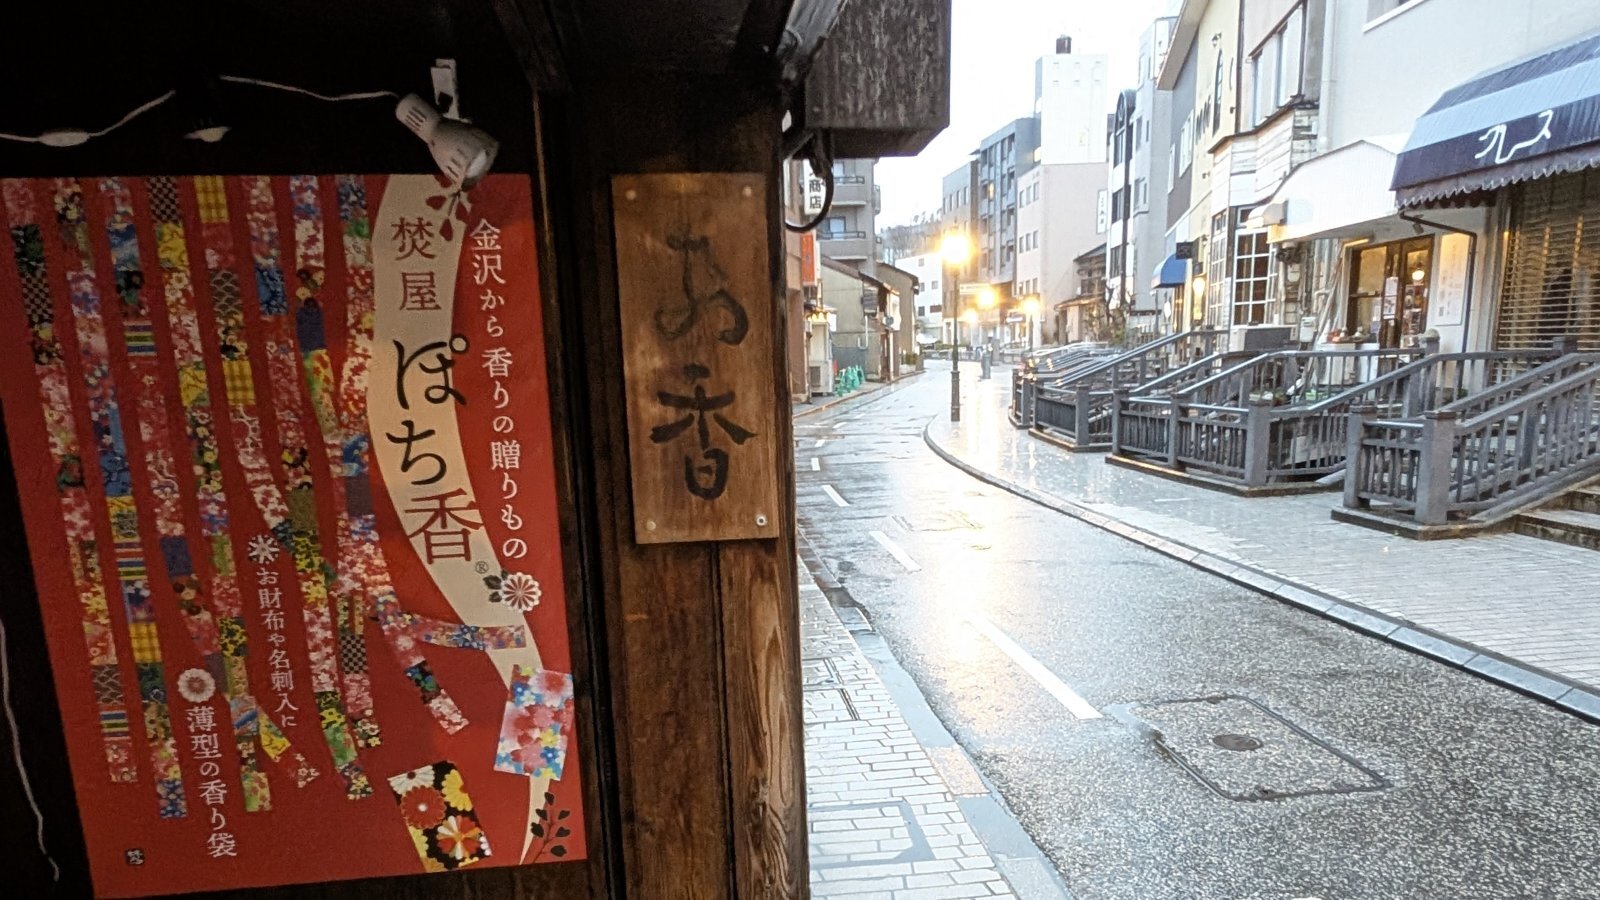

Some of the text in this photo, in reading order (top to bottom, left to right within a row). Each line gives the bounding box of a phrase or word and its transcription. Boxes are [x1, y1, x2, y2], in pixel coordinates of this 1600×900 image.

[386, 217, 484, 563] 焚屋 ぽち香
[470, 218, 528, 560] 金沢から香りの贈りもの
[649, 225, 758, 500] お香
[185, 706, 237, 858] 薄型の香り袋
[256, 567, 299, 728] お財布や名刺入に
